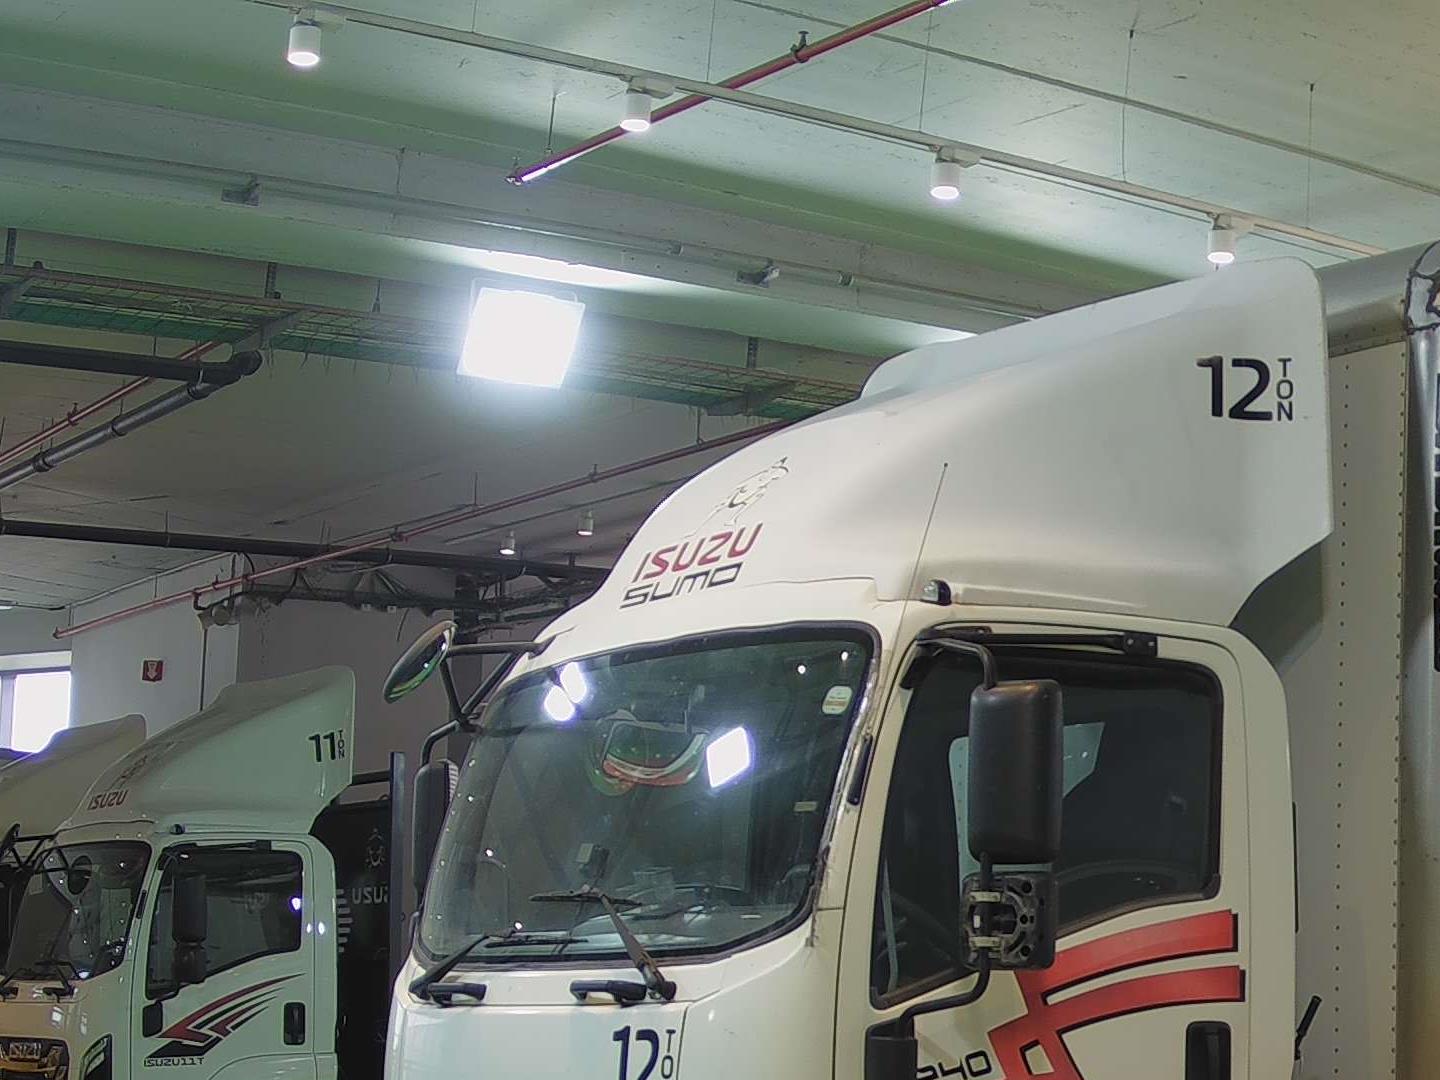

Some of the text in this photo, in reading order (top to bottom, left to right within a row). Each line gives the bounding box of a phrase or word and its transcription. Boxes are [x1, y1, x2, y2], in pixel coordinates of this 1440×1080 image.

[1197, 355, 1273, 421] 12
[1276, 357, 1294, 422] TON
[632, 523, 763, 583] ISUZU
[619, 562, 744, 609] SUMO
[308, 732, 336, 762] 11
[87, 789, 130, 810] ISUZU
